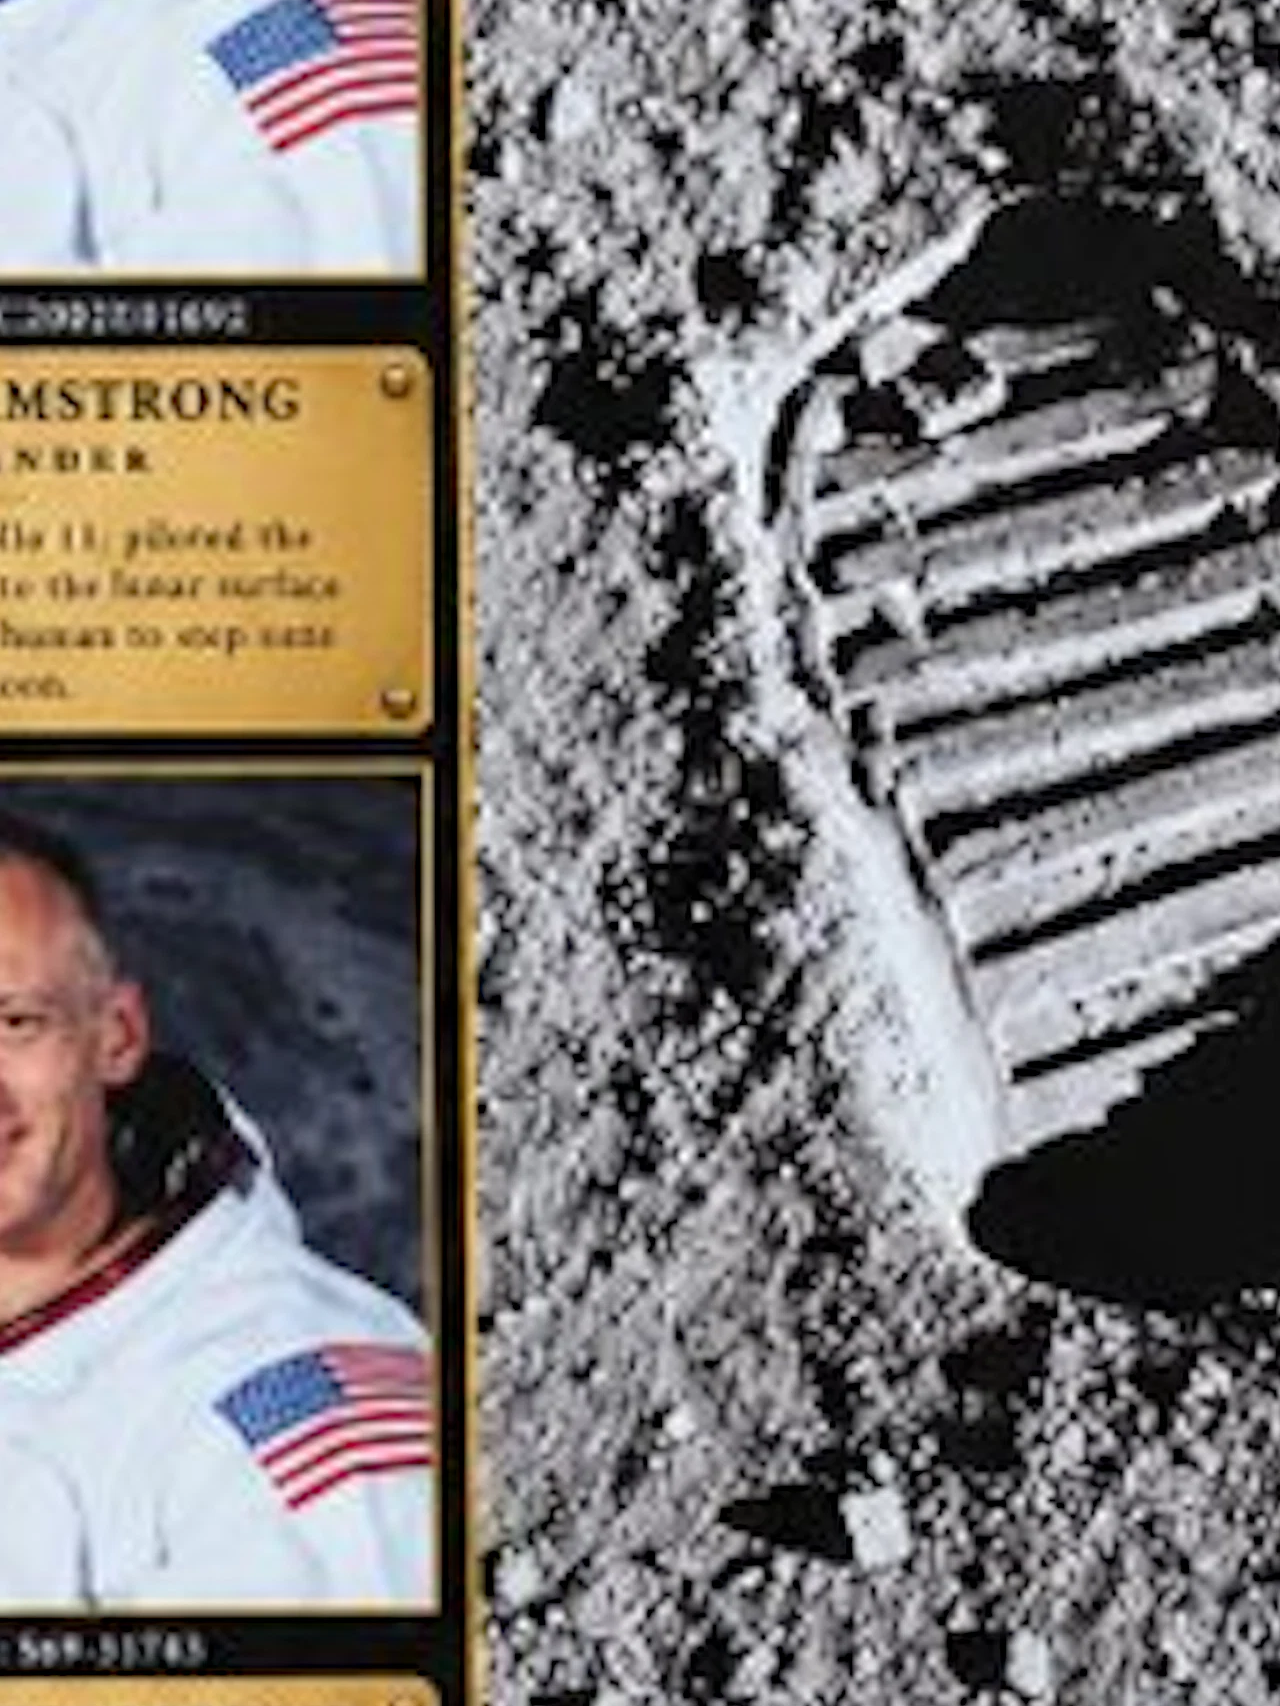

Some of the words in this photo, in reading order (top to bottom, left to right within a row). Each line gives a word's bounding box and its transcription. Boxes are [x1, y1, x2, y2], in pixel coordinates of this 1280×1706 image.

[122, 521, 248, 561] piloted
[258, 521, 314, 553] the
[44, 569, 102, 603] the
[110, 569, 208, 603] lunar
[215, 569, 342, 603] surface
[0, 618, 117, 653] human
[125, 618, 162, 653] to
[173, 621, 252, 661] step
